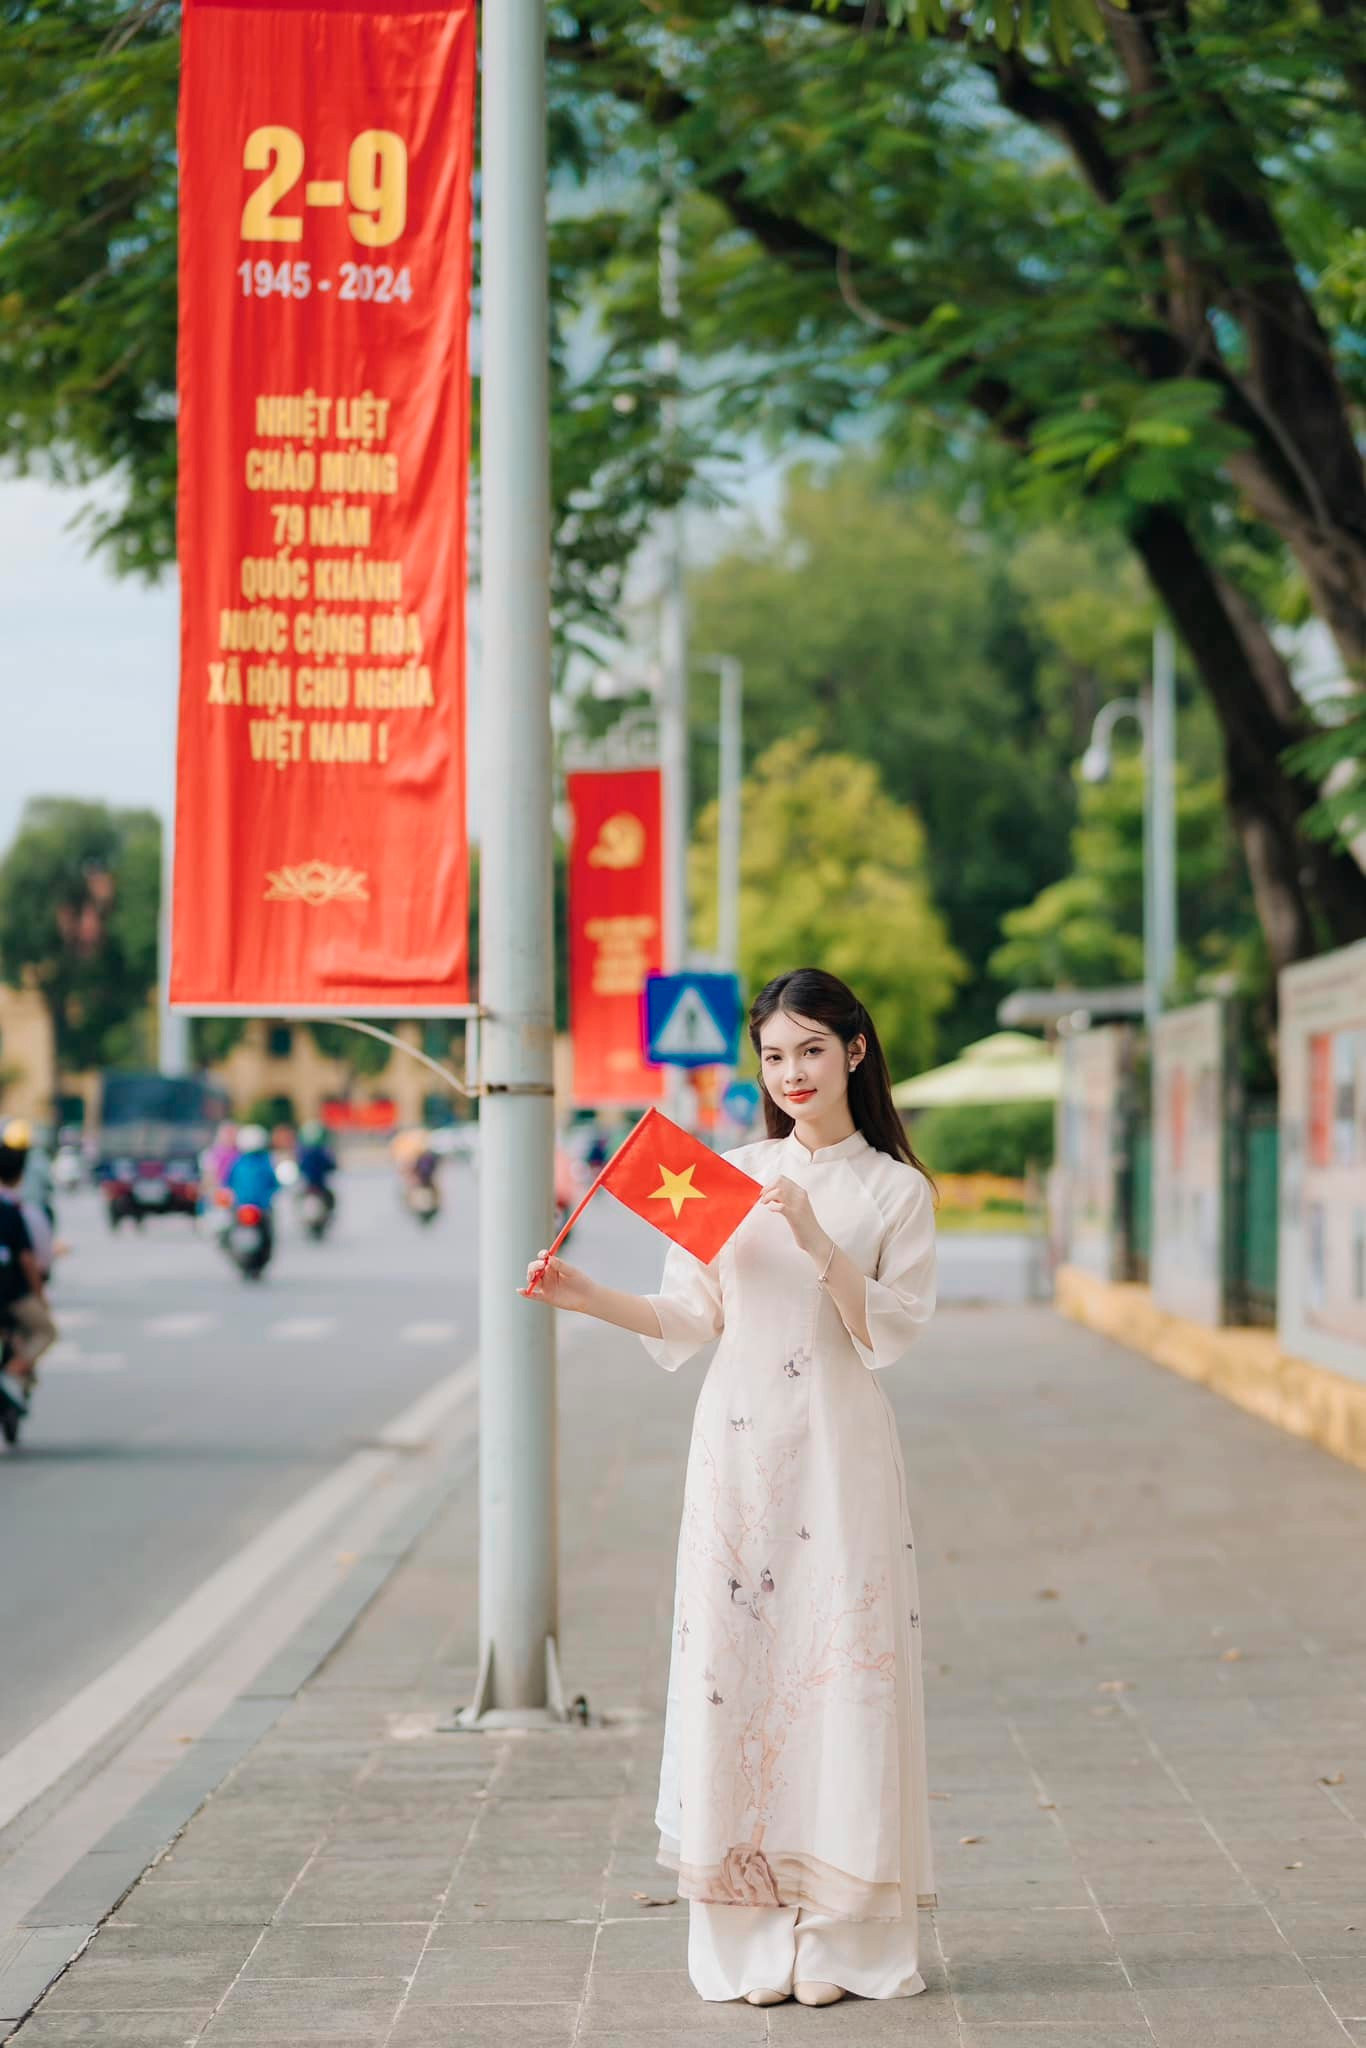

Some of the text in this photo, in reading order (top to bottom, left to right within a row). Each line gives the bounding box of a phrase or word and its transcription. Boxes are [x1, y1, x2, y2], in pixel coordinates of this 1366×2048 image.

[240, 125, 408, 248] 2-9
[237, 259, 311, 299] 1945
[338, 261, 412, 303] 2024
[256, 388, 390, 448] NHIỆT LIỆT
[246, 442, 315, 493] CHÀO
[271, 504, 305, 545] 79
[241, 546, 402, 603] QUỐC KHÁNH
[294, 606, 366, 663] CỘNG
[207, 656, 243, 706] XÃ
[247, 658, 292, 716] HỘI
[296, 656, 349, 709] CHỦ
[249, 713, 304, 771] VIỆT
[309, 721, 371, 763] NAM
